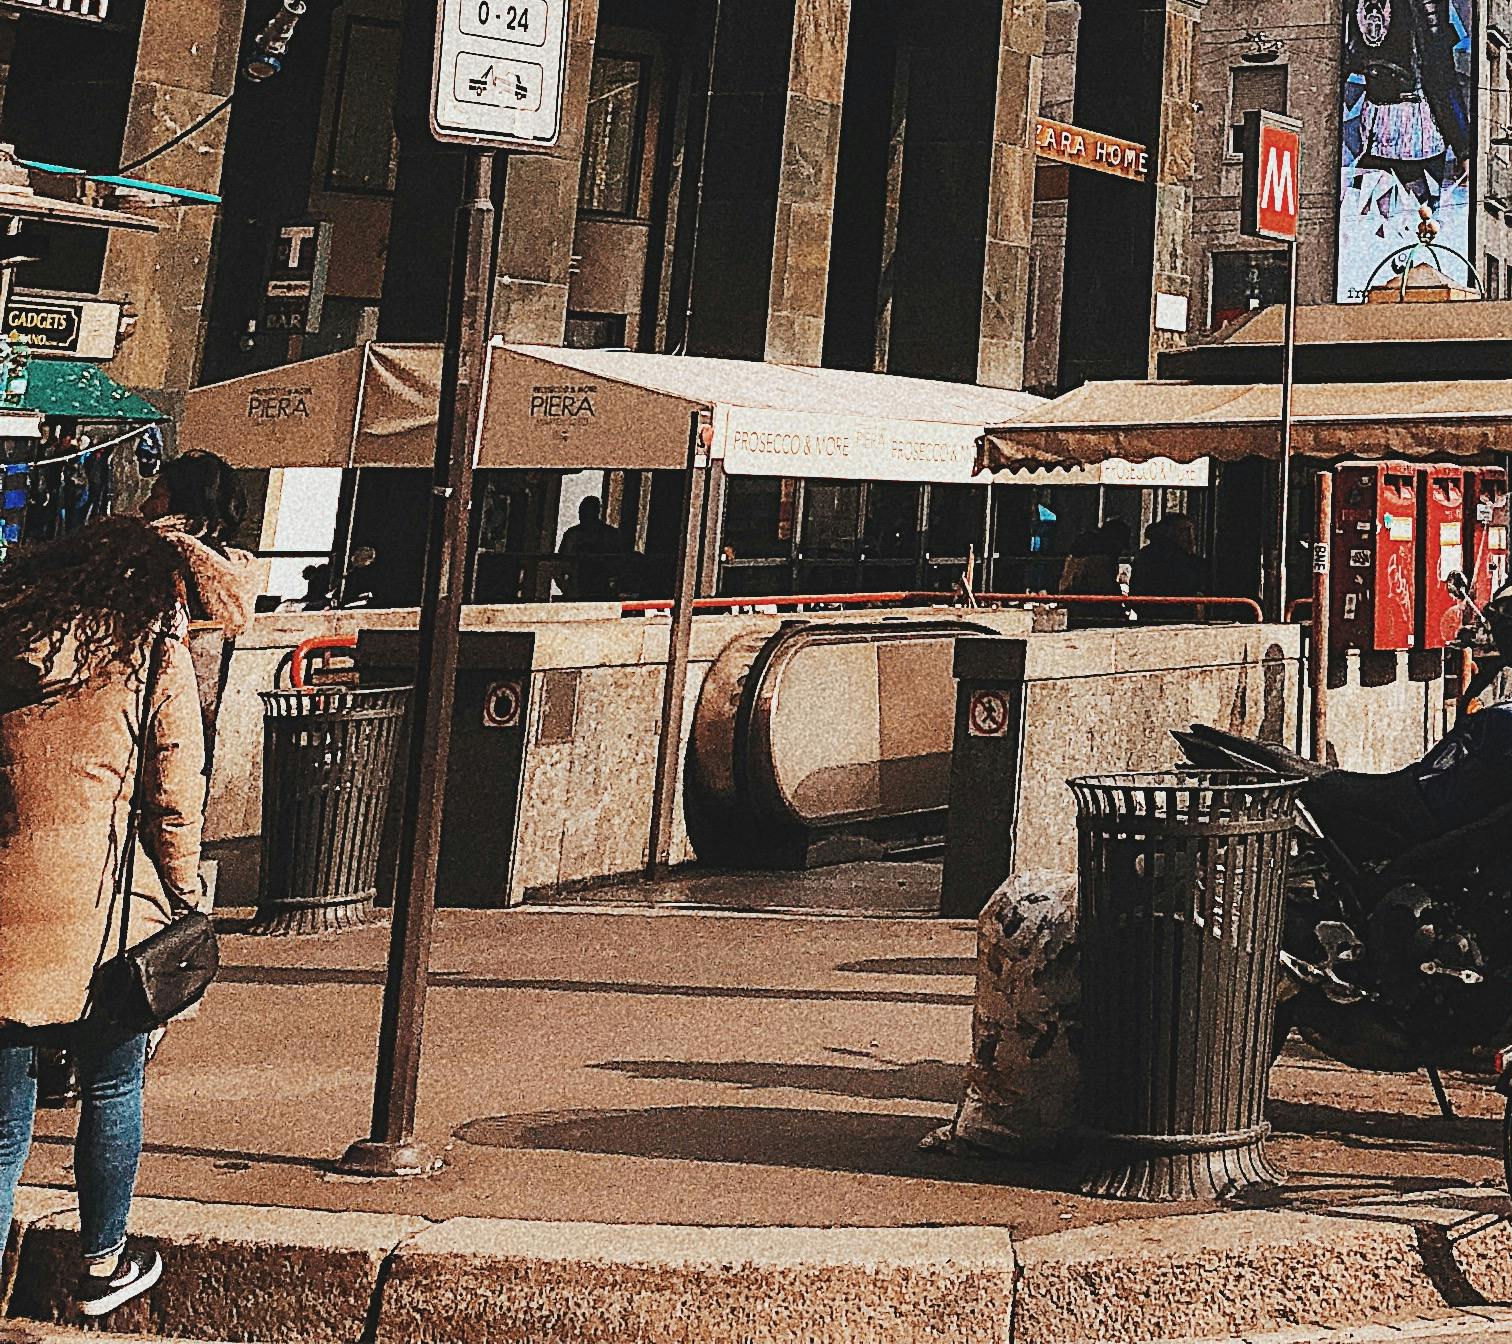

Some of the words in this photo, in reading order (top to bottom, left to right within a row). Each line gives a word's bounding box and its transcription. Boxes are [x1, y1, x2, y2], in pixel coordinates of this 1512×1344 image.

[1095, 140, 1149, 173] HOME
[1261, 146, 1294, 216] M
[280, 226, 315, 268] T
[8, 310, 67, 330] GADGETS
[248, 396, 309, 418] PIERA
[530, 395, 596, 417] PIERA
[733, 430, 801, 456] PROSECCO
[816, 436, 849, 457] MORE
